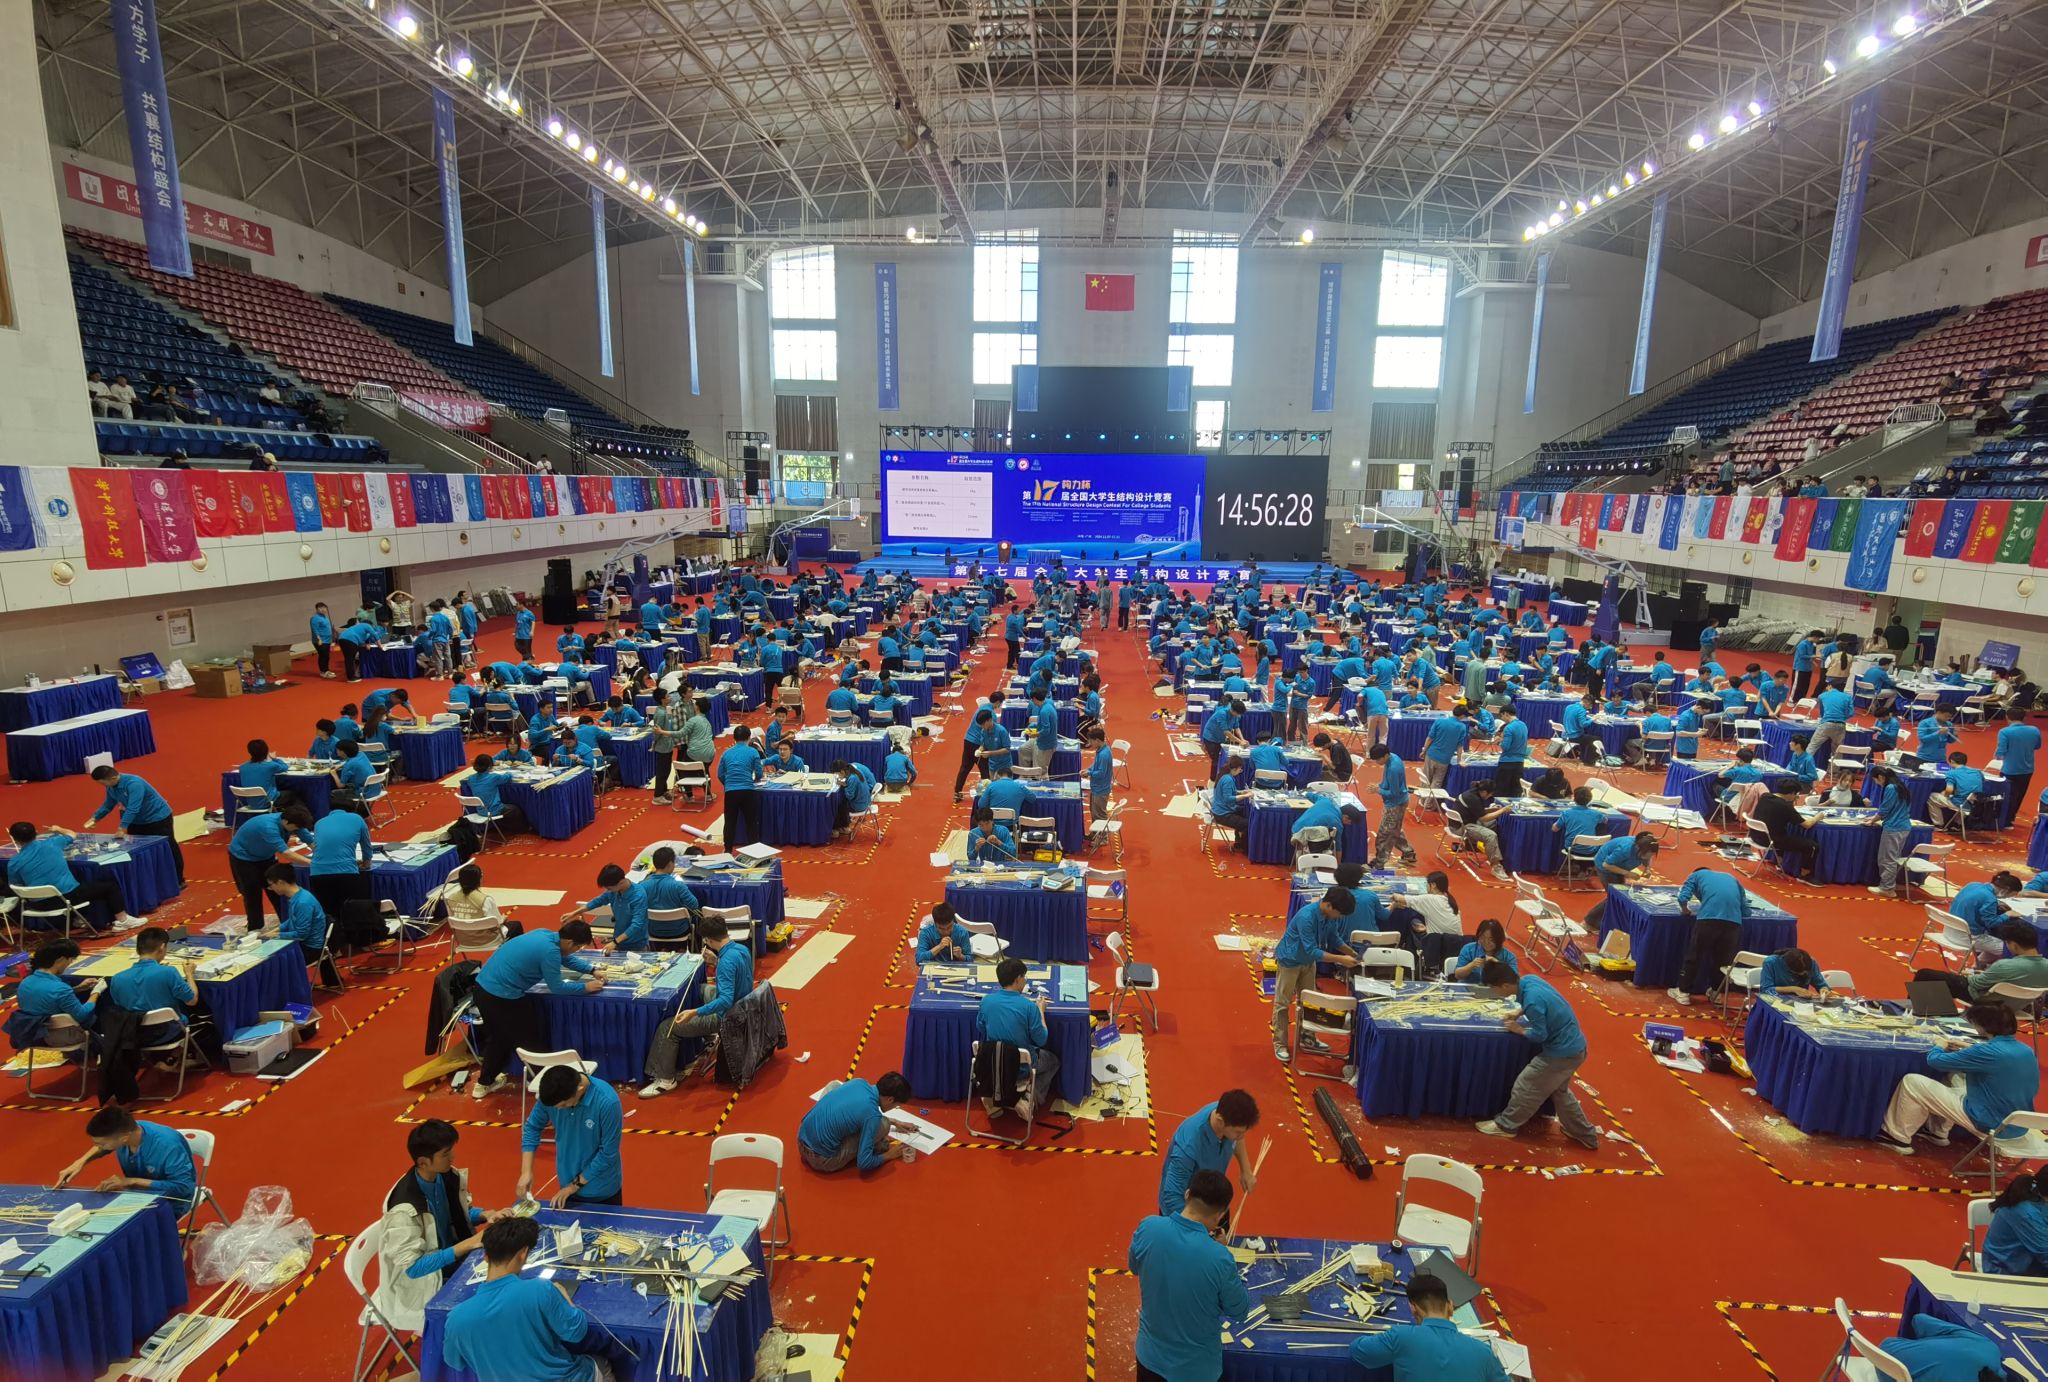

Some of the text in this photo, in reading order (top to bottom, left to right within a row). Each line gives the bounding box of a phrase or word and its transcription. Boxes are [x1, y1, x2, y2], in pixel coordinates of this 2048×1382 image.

[142, 91, 171, 208] 共襄结构盛会
[203, 211, 230, 232] 文明
[1022, 490, 1031, 500] 第
[1034, 479, 1060, 501] 17
[1061, 491, 1172, 502] 届全国大学生结构设计竞赛
[1217, 492, 1313, 527] 14:56:28
